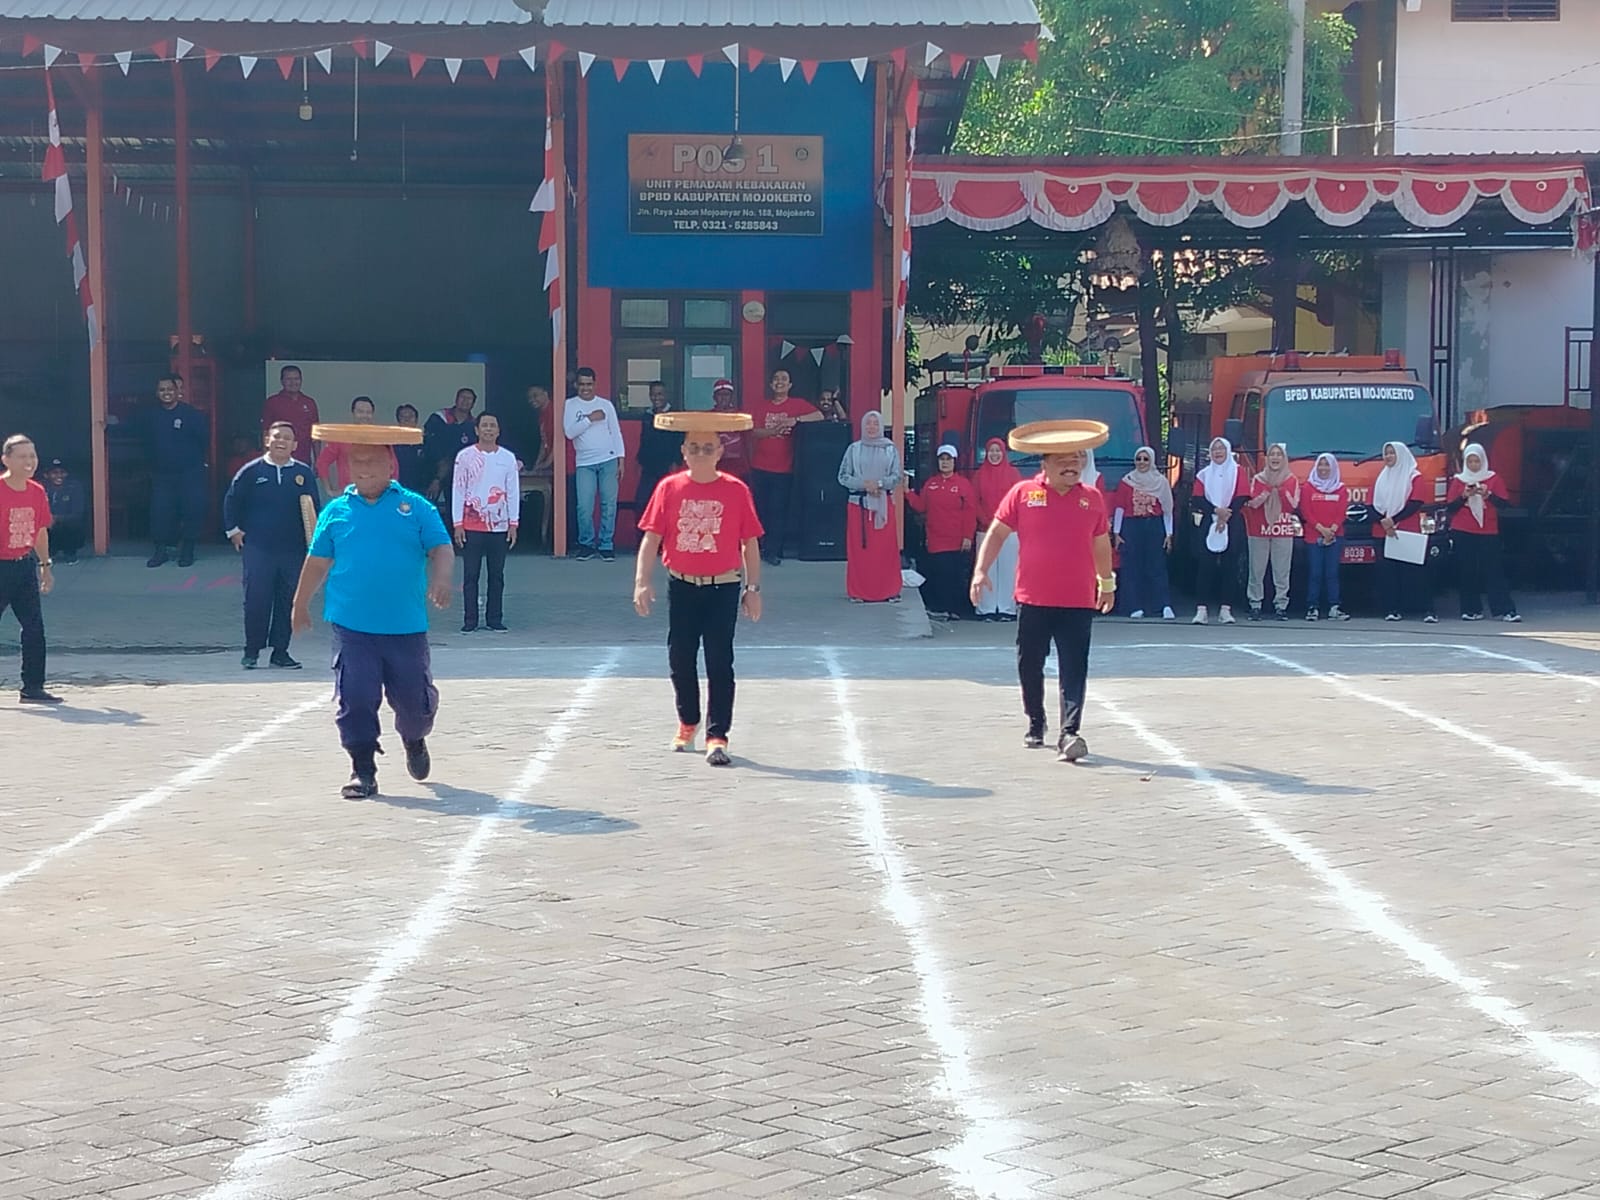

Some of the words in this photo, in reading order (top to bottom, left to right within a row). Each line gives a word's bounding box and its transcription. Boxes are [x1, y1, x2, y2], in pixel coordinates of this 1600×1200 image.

[756, 144, 780, 174] 1
[646, 180, 672, 190] UNIT
[675, 180, 732, 190] PEMADAM
[735, 181, 806, 190] KEBAKARAN
[639, 192, 672, 202] BPBD
[674, 192, 741, 203] KABUPATEN
[742, 193, 812, 203] MOJOKERTO
[673, 220, 700, 230] TELP.
[702, 220, 727, 230] 0321
[1284, 389, 1309, 401] BPBD
[1310, 387, 1360, 400] KABUPATEN
[1362, 387, 1415, 400] MOJOKERTO
[1260, 524, 1294, 536] MORE
